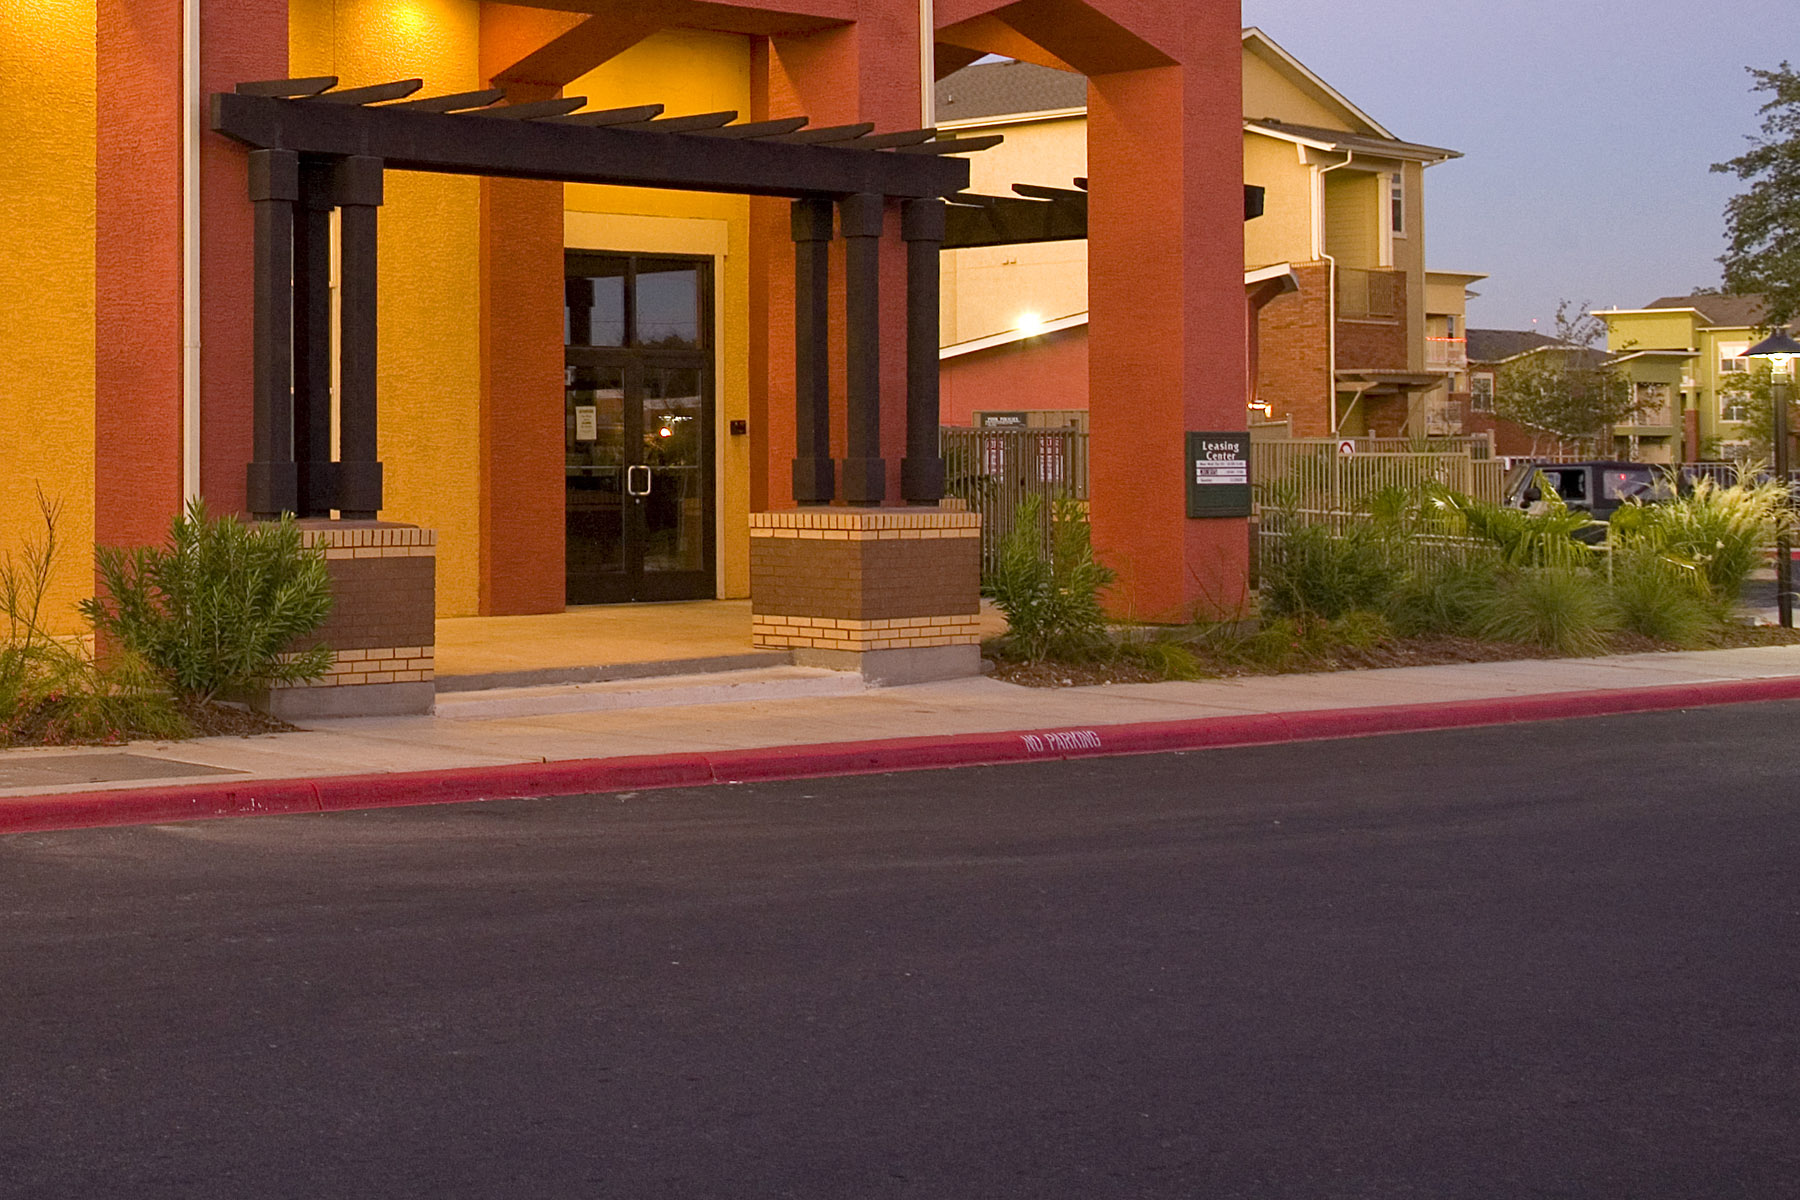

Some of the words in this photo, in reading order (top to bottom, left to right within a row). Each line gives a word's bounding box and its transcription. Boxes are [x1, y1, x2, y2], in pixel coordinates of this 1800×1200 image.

[1202, 441, 1239, 453] Leasing
[1206, 451, 1235, 460] Center
[1020, 734, 1043, 752] NO
[1044, 730, 1101, 751] PARKING
